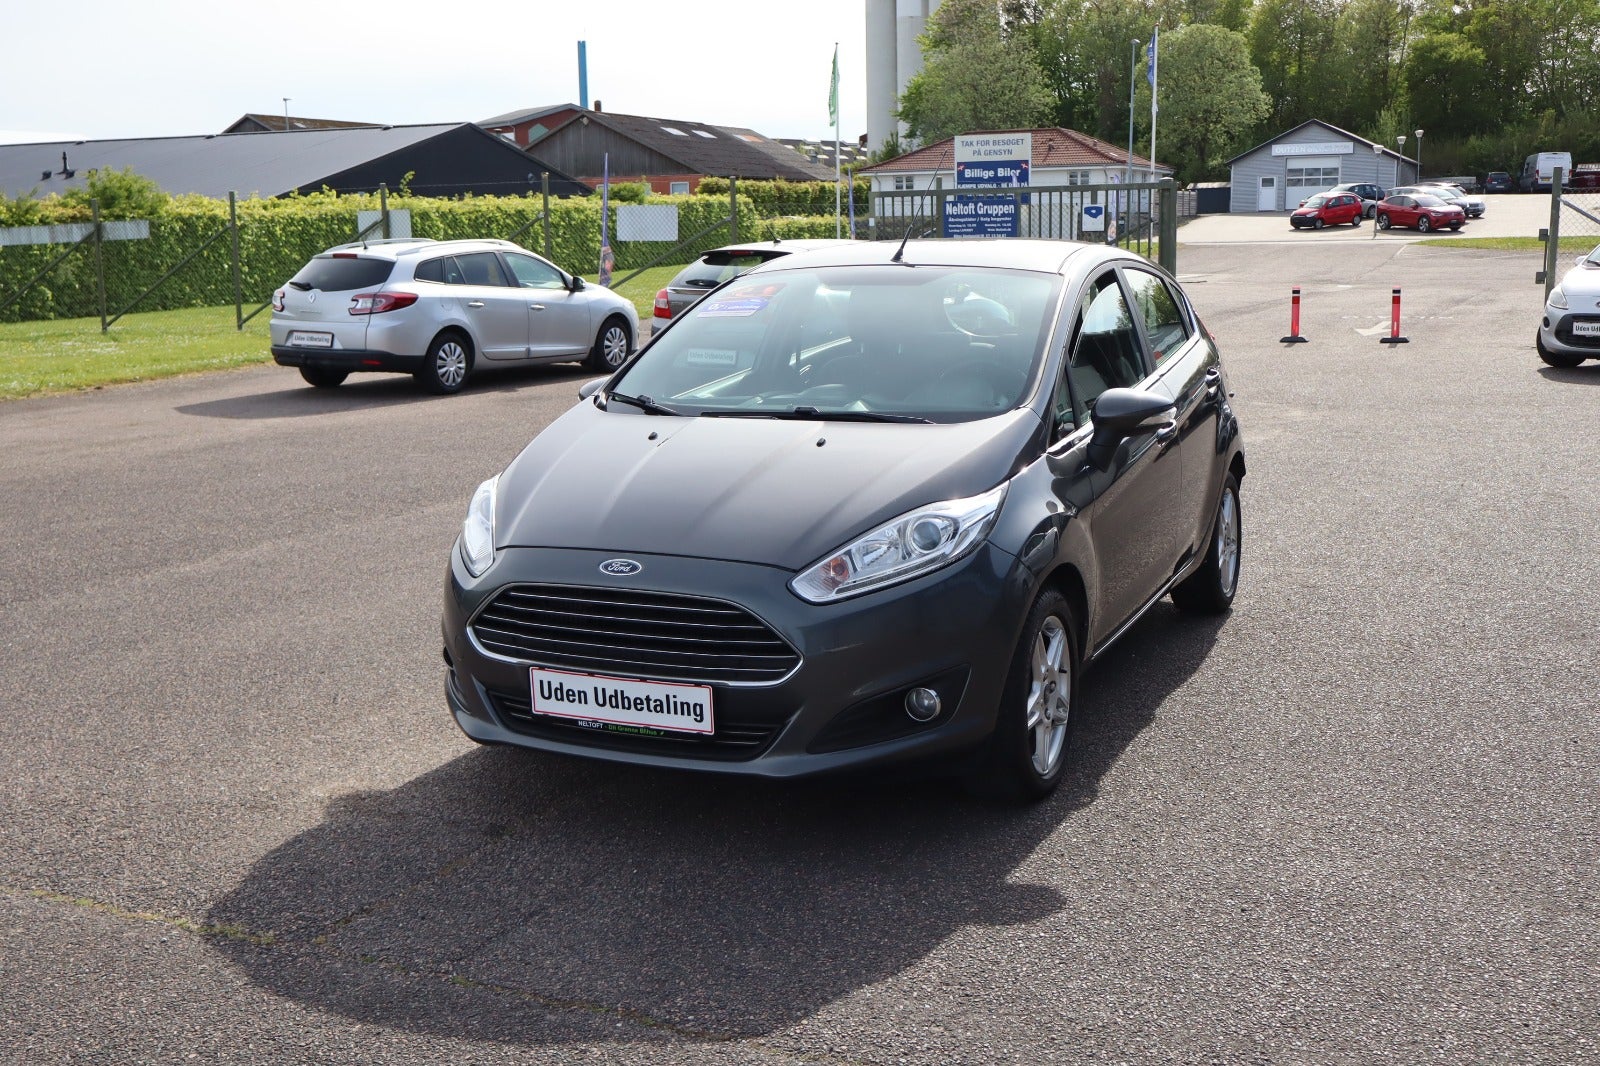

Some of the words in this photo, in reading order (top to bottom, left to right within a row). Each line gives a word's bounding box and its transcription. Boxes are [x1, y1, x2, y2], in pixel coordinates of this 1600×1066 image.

[965, 168, 994, 179] Billige
[998, 168, 1021, 177] Biler
[946, 203, 975, 215] Neltoft
[977, 202, 1014, 216] Gruppen
[608, 561, 632, 572] Ford
[539, 679, 588, 705] Uden
[594, 686, 704, 723] Udbetaling
[578, 720, 604, 729] NELTOFT
